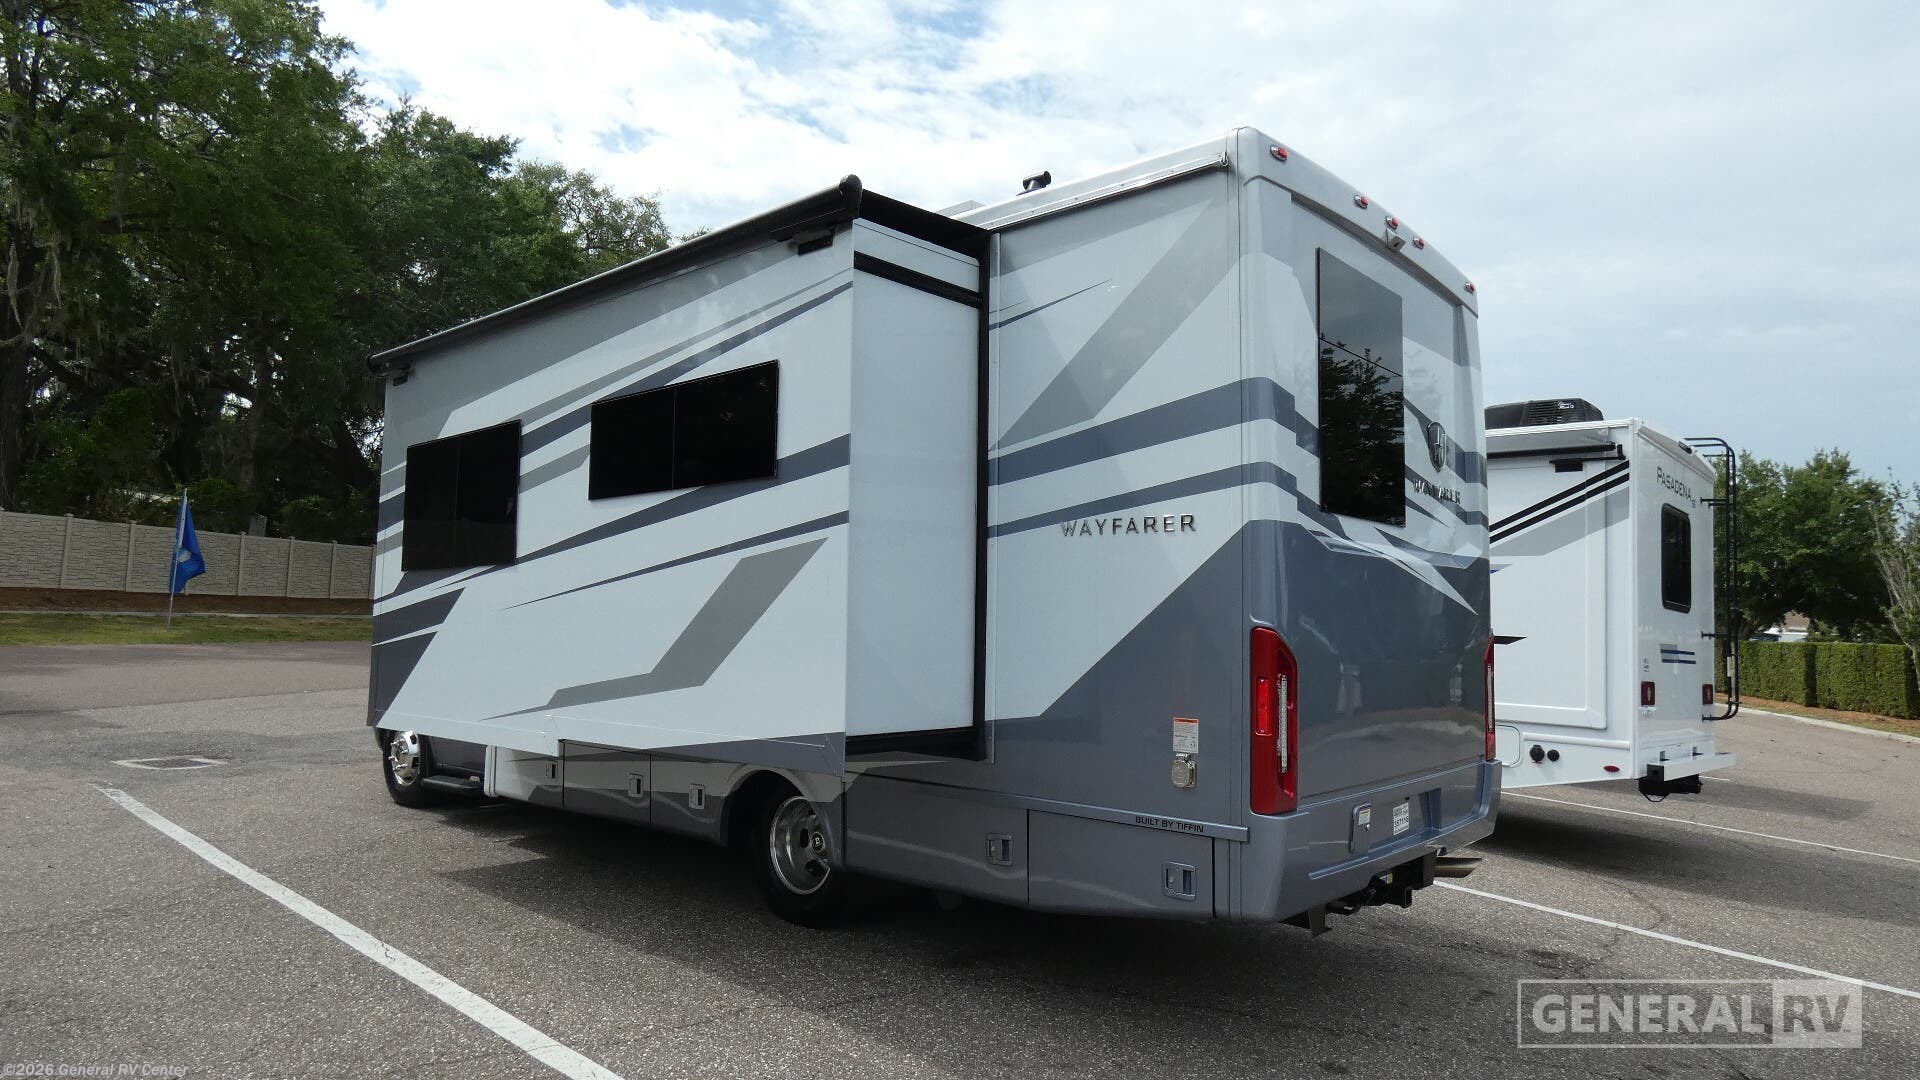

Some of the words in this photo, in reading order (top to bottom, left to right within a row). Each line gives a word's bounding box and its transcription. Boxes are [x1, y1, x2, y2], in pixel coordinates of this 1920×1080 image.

[1656, 465, 1692, 501] PASADENA
[1060, 514, 1196, 537] WAYFARER
[1135, 816, 1159, 826] BUILT
[1161, 820, 1174, 829] BY
[1176, 821, 1204, 833] TIFFIN
